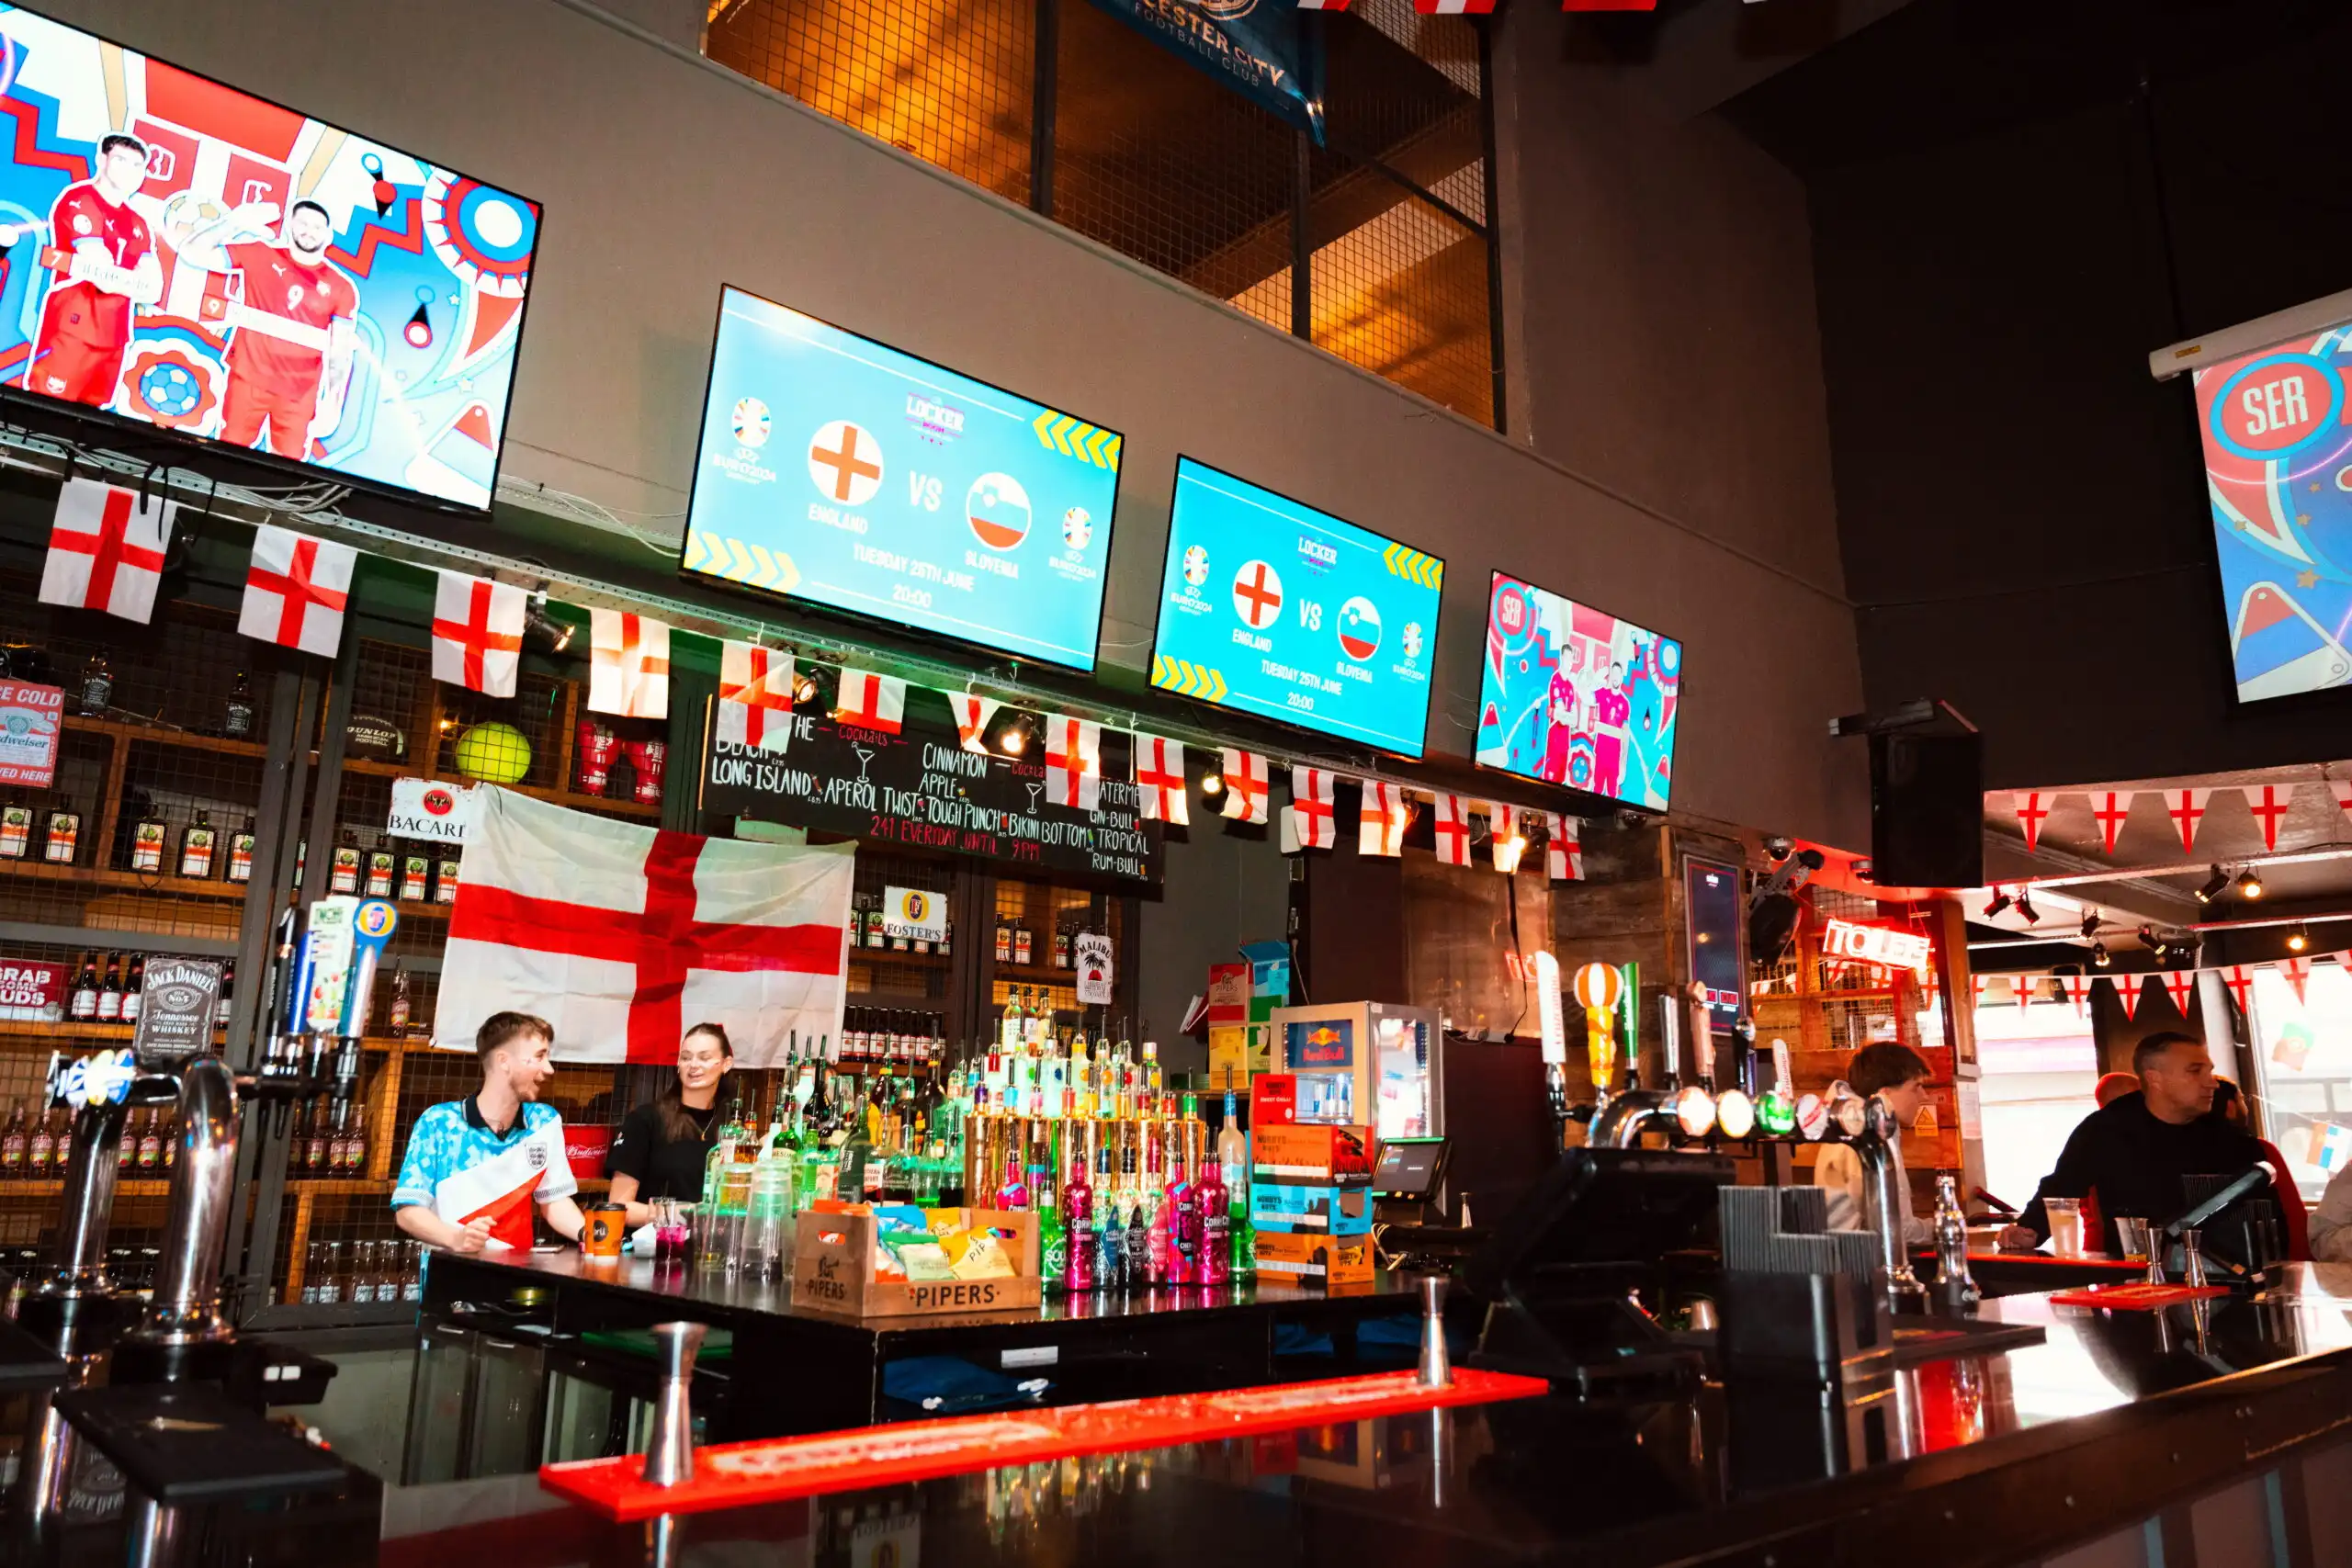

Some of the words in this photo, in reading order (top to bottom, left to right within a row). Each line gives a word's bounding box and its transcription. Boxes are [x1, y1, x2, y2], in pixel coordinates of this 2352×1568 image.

[1135, 2, 1214, 61] FOOTBALL
[1221, 57, 1261, 87] CLUB
[1233, 47, 1285, 87] CITY
[51, 252, 63, 265] 7
[208, 299, 220, 314] 9
[287, 284, 305, 310] 9
[906, 395, 964, 433] LOCKER
[2242, 375, 2309, 436] SER
[909, 469, 944, 513] VS
[808, 502, 869, 536] ENGLAND
[965, 548, 1019, 580] SLOVENIA
[1297, 536, 1339, 566] LOCKER
[853, 542, 909, 573] TUESDAY
[942, 570, 975, 593] JUNE
[891, 582, 933, 609] 20:00
[1299, 598, 1323, 632] VS
[1501, 594, 1521, 628] SER
[1231, 627, 1272, 652] ENGLAND
[1261, 659, 1300, 682] TUESDAY
[1320, 679, 1343, 696] JUNE
[1335, 660, 1374, 684] SLOVENIA
[17, 689, 62, 706] COLD
[1287, 691, 1315, 711] 20:00
[0, 734, 49, 749] dweiser
[346, 726, 396, 739] DUNLOP
[922, 742, 988, 780] CINNAMON
[20, 769, 52, 783] HERE
[712, 755, 752, 787] LONG
[754, 763, 811, 796] ISLAND
[918, 772, 958, 800] APPLE
[824, 777, 877, 812] APEROL
[883, 786, 922, 818] TWIST
[1099, 781, 1140, 809] ATERME
[390, 814, 467, 839] BACAR
[925, 795, 962, 827] TOUGH
[964, 803, 1001, 832] PUNCH
[1090, 808, 1134, 832] GIN-BULL
[870, 815, 896, 838] 241
[900, 818, 958, 847] EVERYDAY
[965, 833, 999, 855] UNTIL
[1009, 812, 1039, 840] BIKINI
[1041, 821, 1088, 850] BOTTOM
[1096, 828, 1150, 855] TROPICAL
[1091, 852, 1140, 876] RUM-BULL
[887, 922, 942, 940] FOSTER'S
[1079, 941, 1112, 959] MALIBU
[147, 969, 175, 991] JACK
[175, 965, 218, 993] DANIEL'S
[0, 989, 46, 1005] UDS
[152, 1010, 200, 1021] Tennessee
[152, 1024, 198, 1035] WHISKEY
[808, 1278, 845, 1301] PIPERS
[917, 1283, 995, 1308] PIPERS
